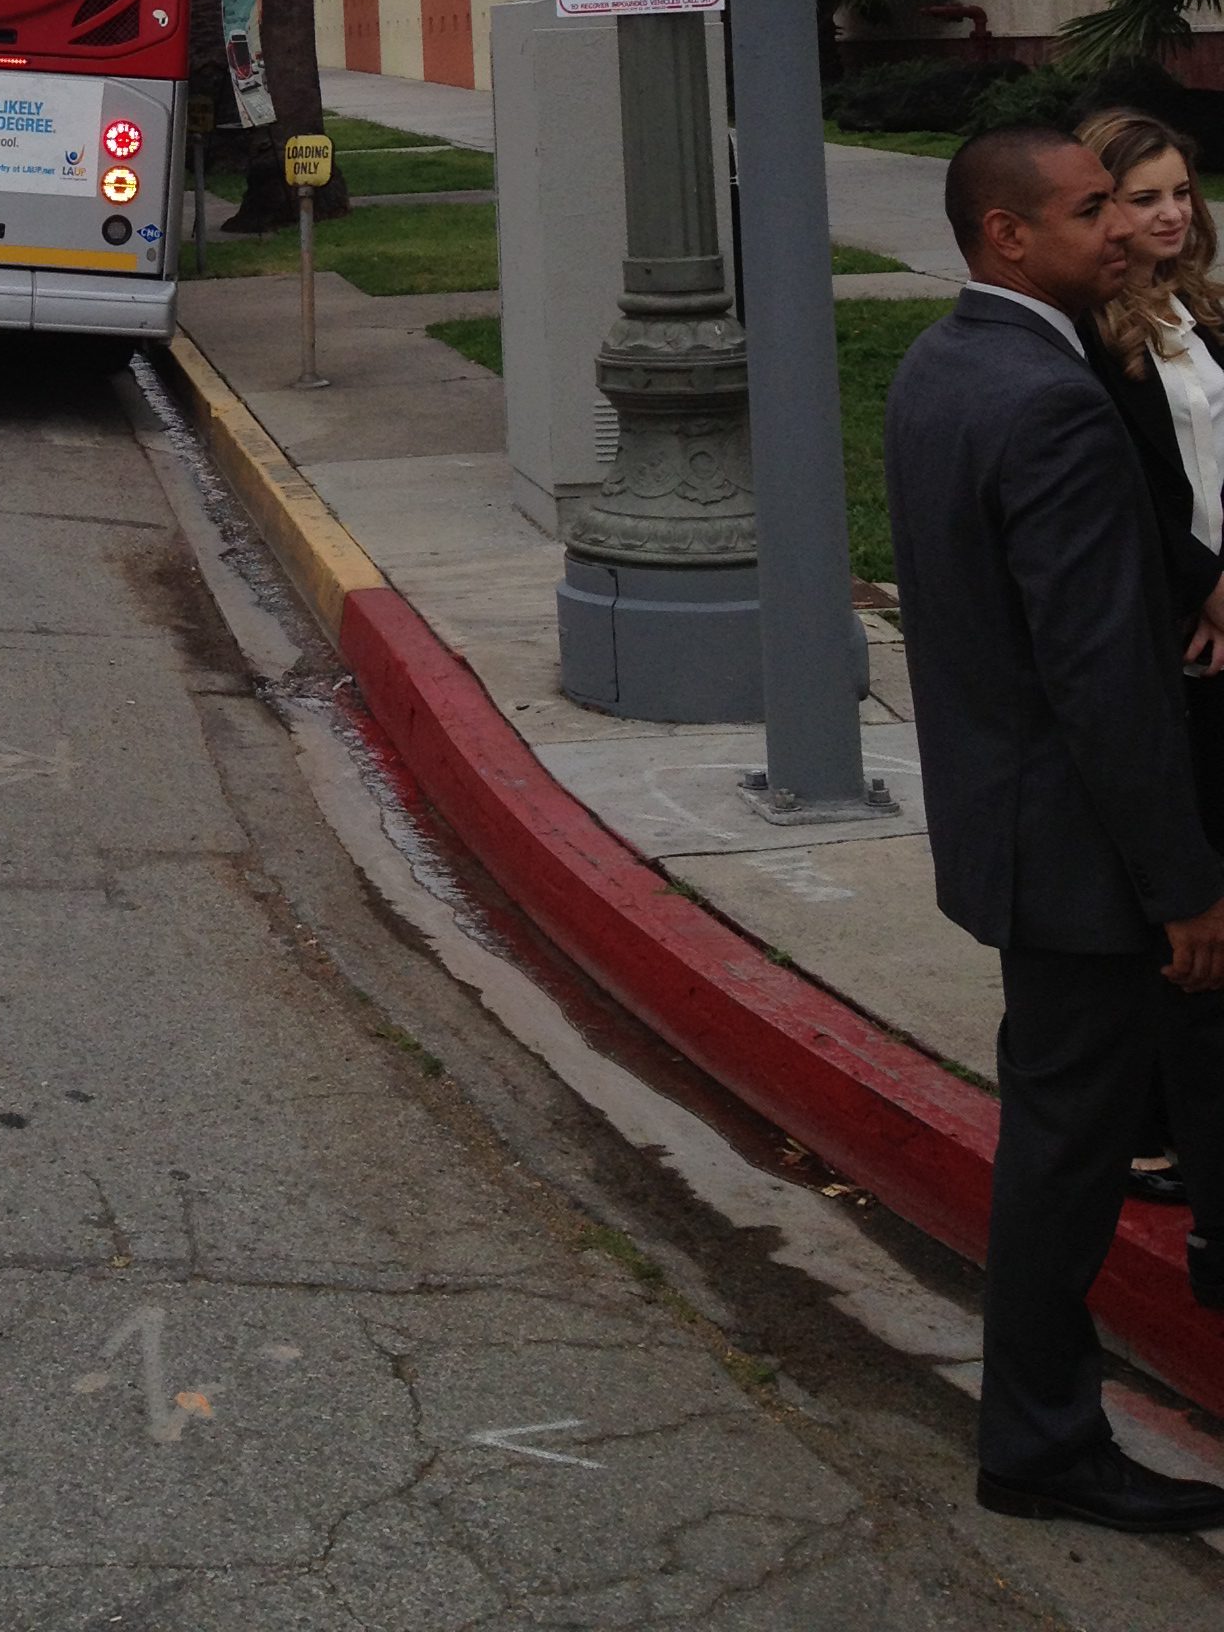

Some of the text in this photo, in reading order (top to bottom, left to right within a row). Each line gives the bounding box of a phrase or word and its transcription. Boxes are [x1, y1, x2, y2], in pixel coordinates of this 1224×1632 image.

[287, 145, 329, 159] LOADING
[62, 167, 87, 176] LAUP
[293, 161, 320, 175] ONLY
[140, 228, 160, 238] CNG
